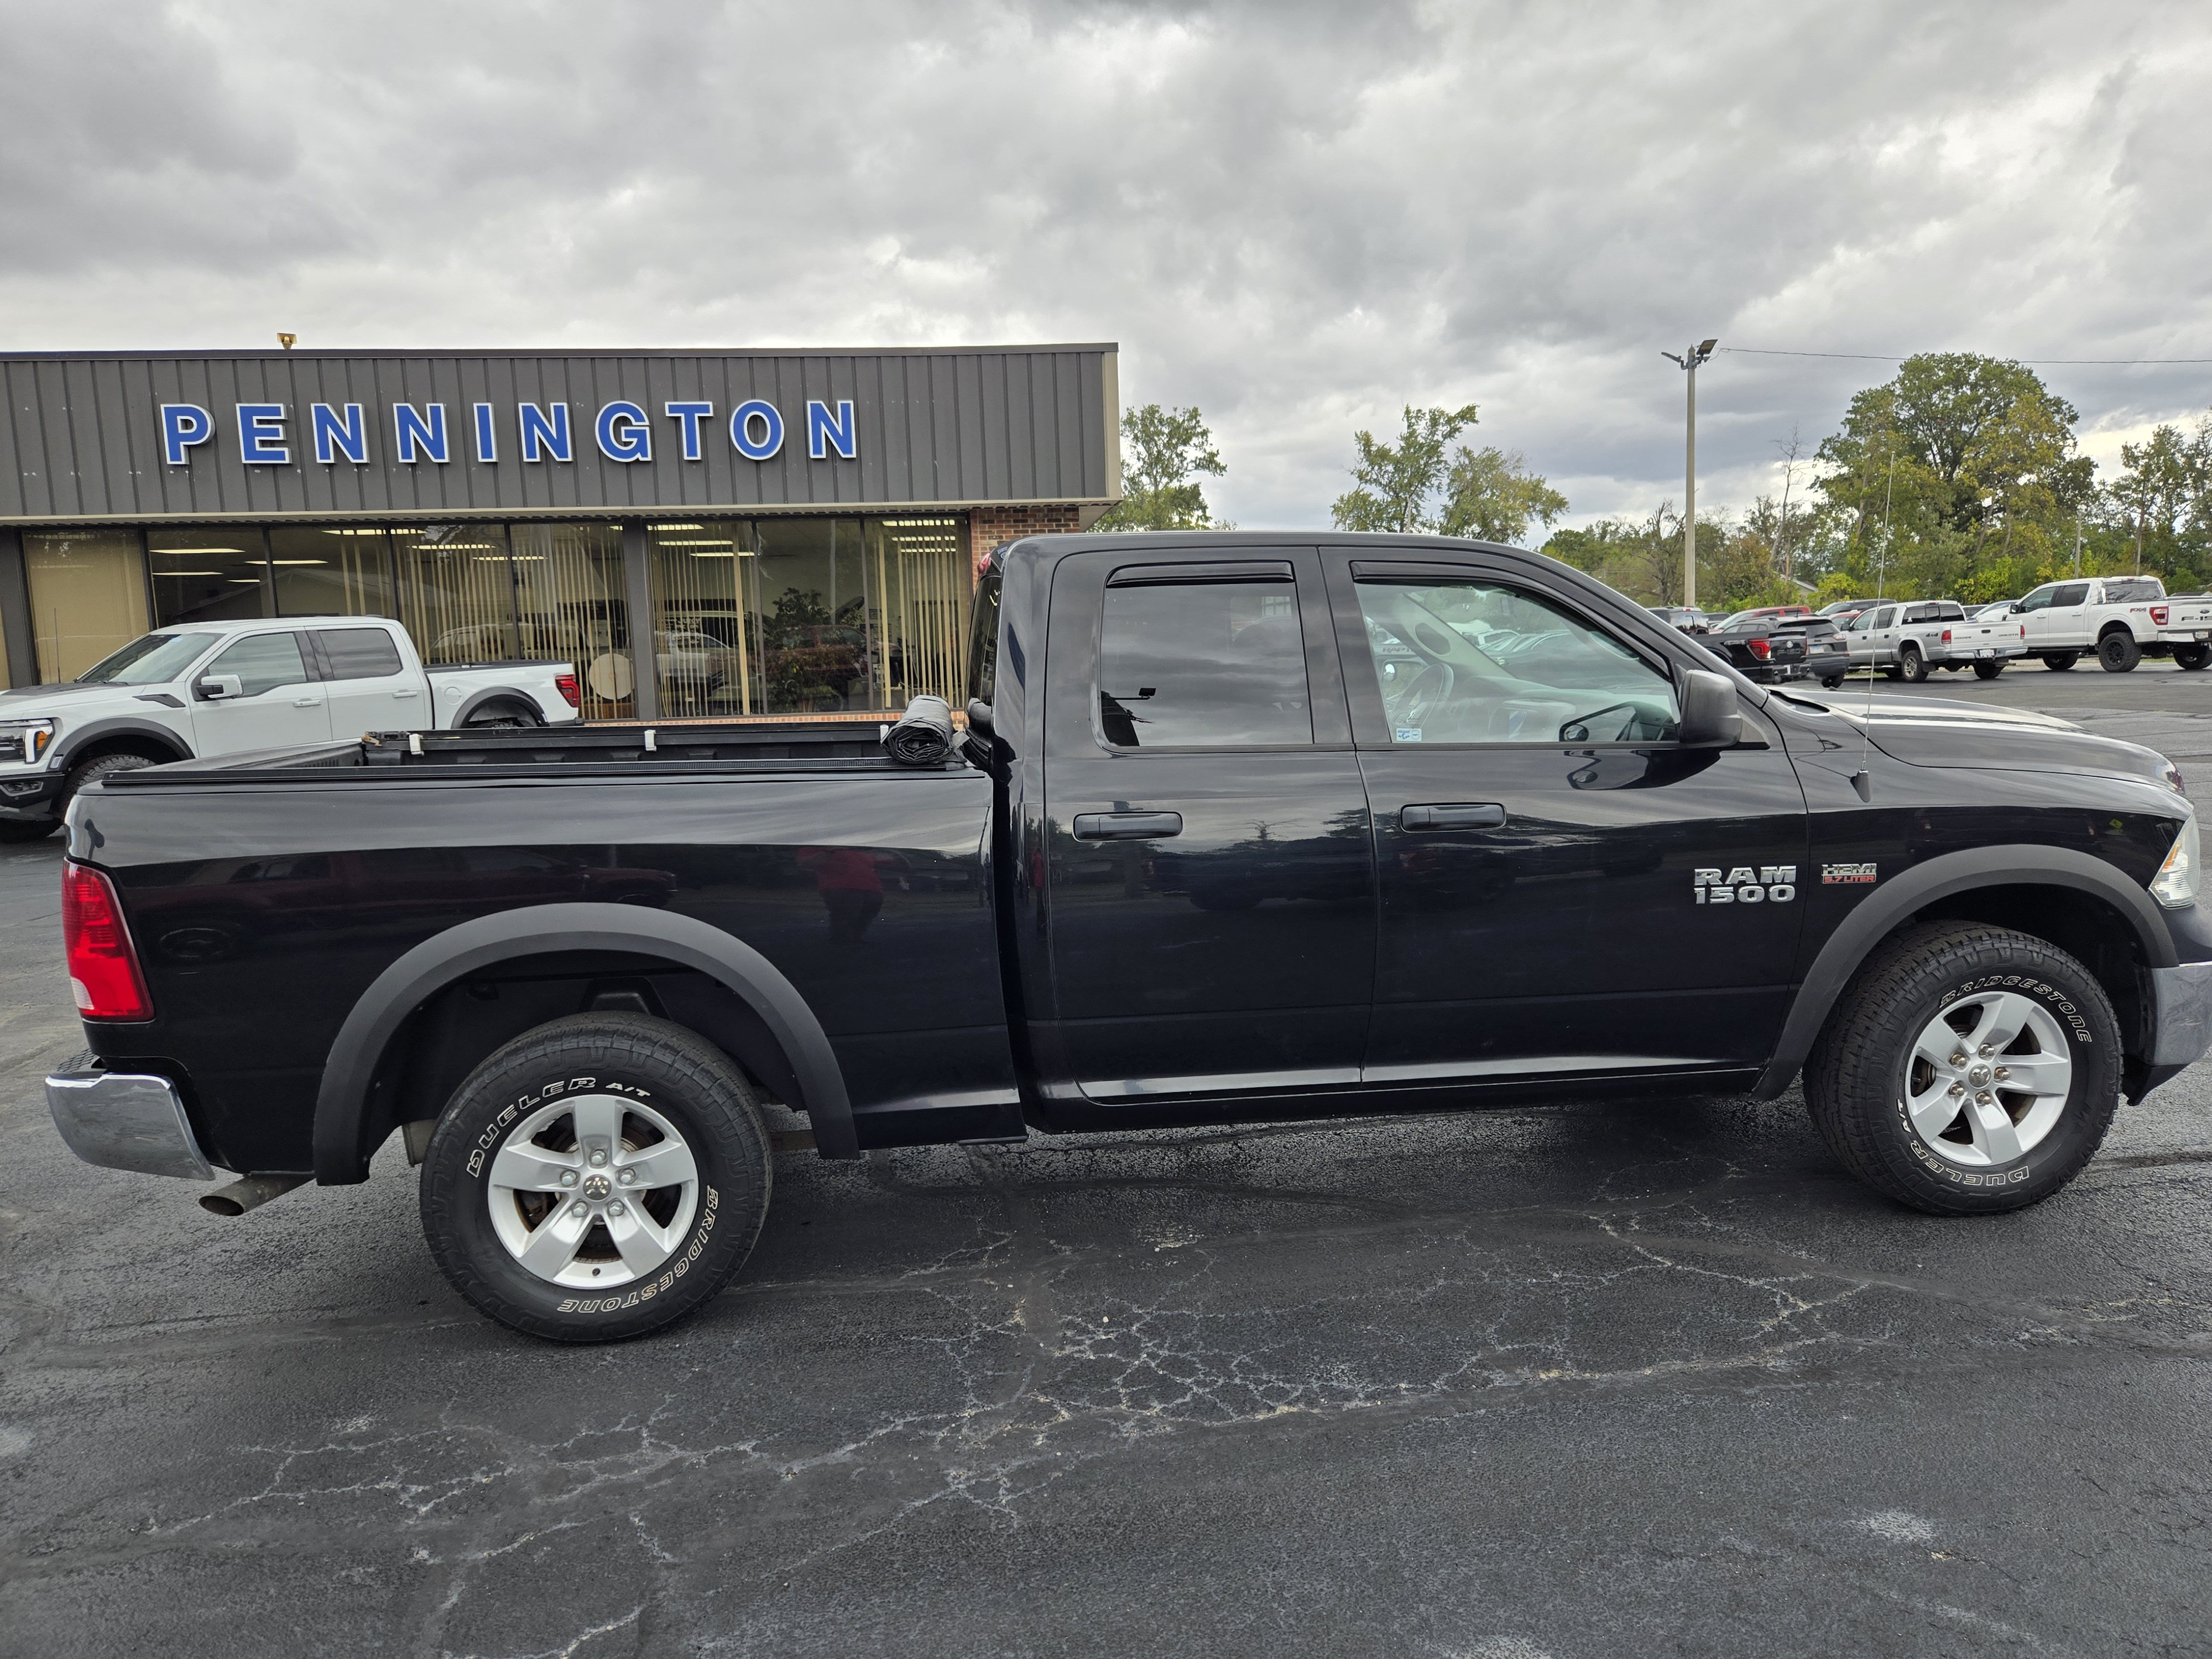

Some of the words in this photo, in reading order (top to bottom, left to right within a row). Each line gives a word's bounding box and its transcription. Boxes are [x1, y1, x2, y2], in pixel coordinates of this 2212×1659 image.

[160, 399, 857, 465] PENNINGTON
[1694, 865, 1797, 885] RAM
[1694, 885, 1796, 904] 1500
[1822, 863, 1877, 874] HEMI
[1939, 975, 2092, 1042] BRIDGESTONE
[466, 1077, 596, 1178] DUELER
[606, 1082, 650, 1097] A/T
[1911, 1140, 2030, 1186] DUELER
[557, 1185, 718, 1313] BRIDGESTONE
